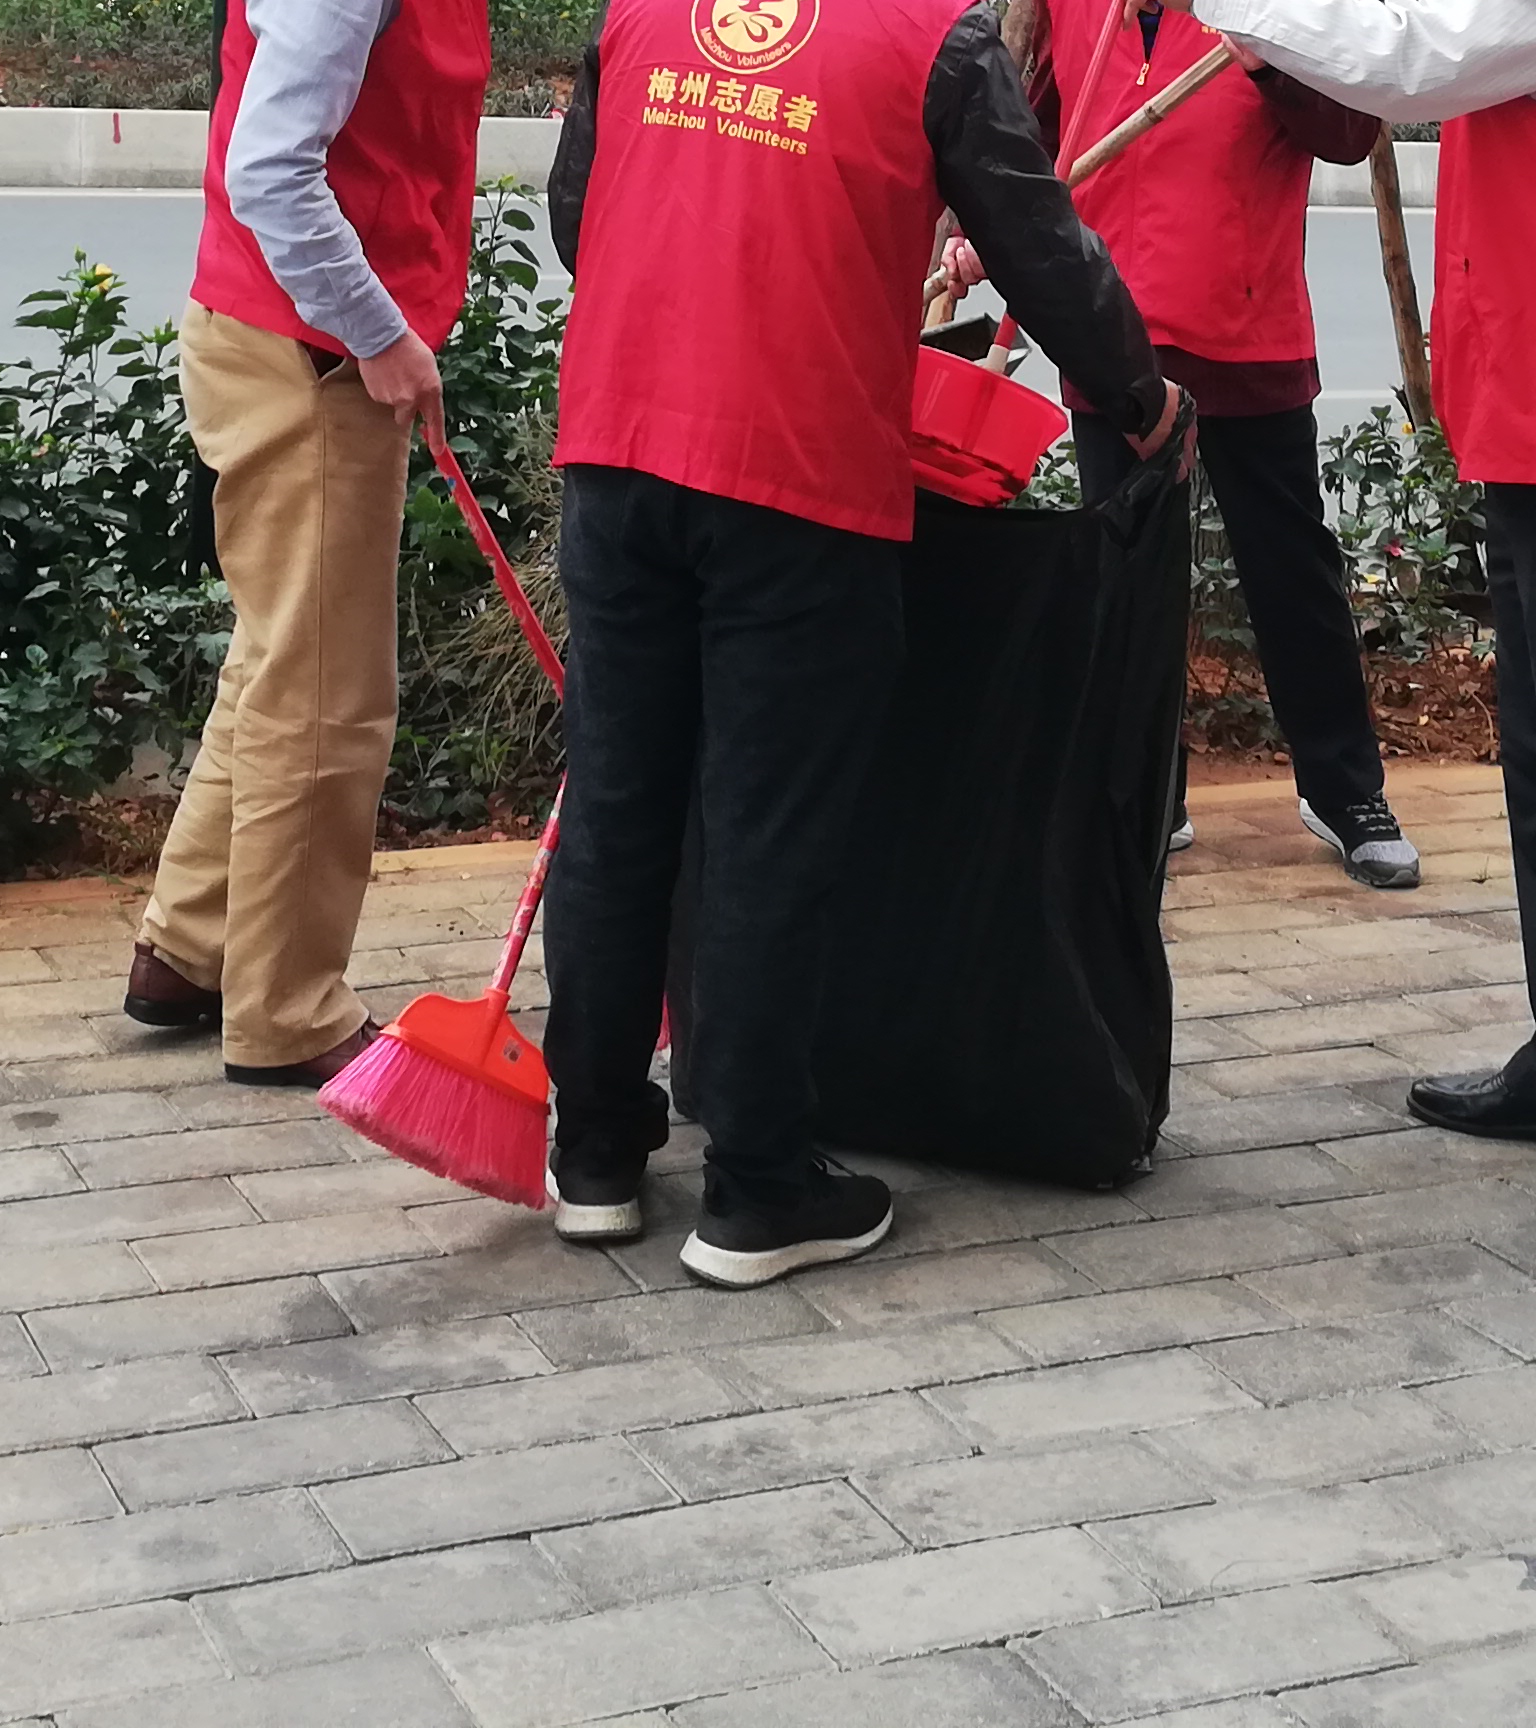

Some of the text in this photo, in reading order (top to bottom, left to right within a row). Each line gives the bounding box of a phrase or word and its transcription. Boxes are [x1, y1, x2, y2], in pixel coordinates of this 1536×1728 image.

[647, 67, 818, 132] 梅州志愿者
[643, 106, 807, 155] Meizhou Volunteers
